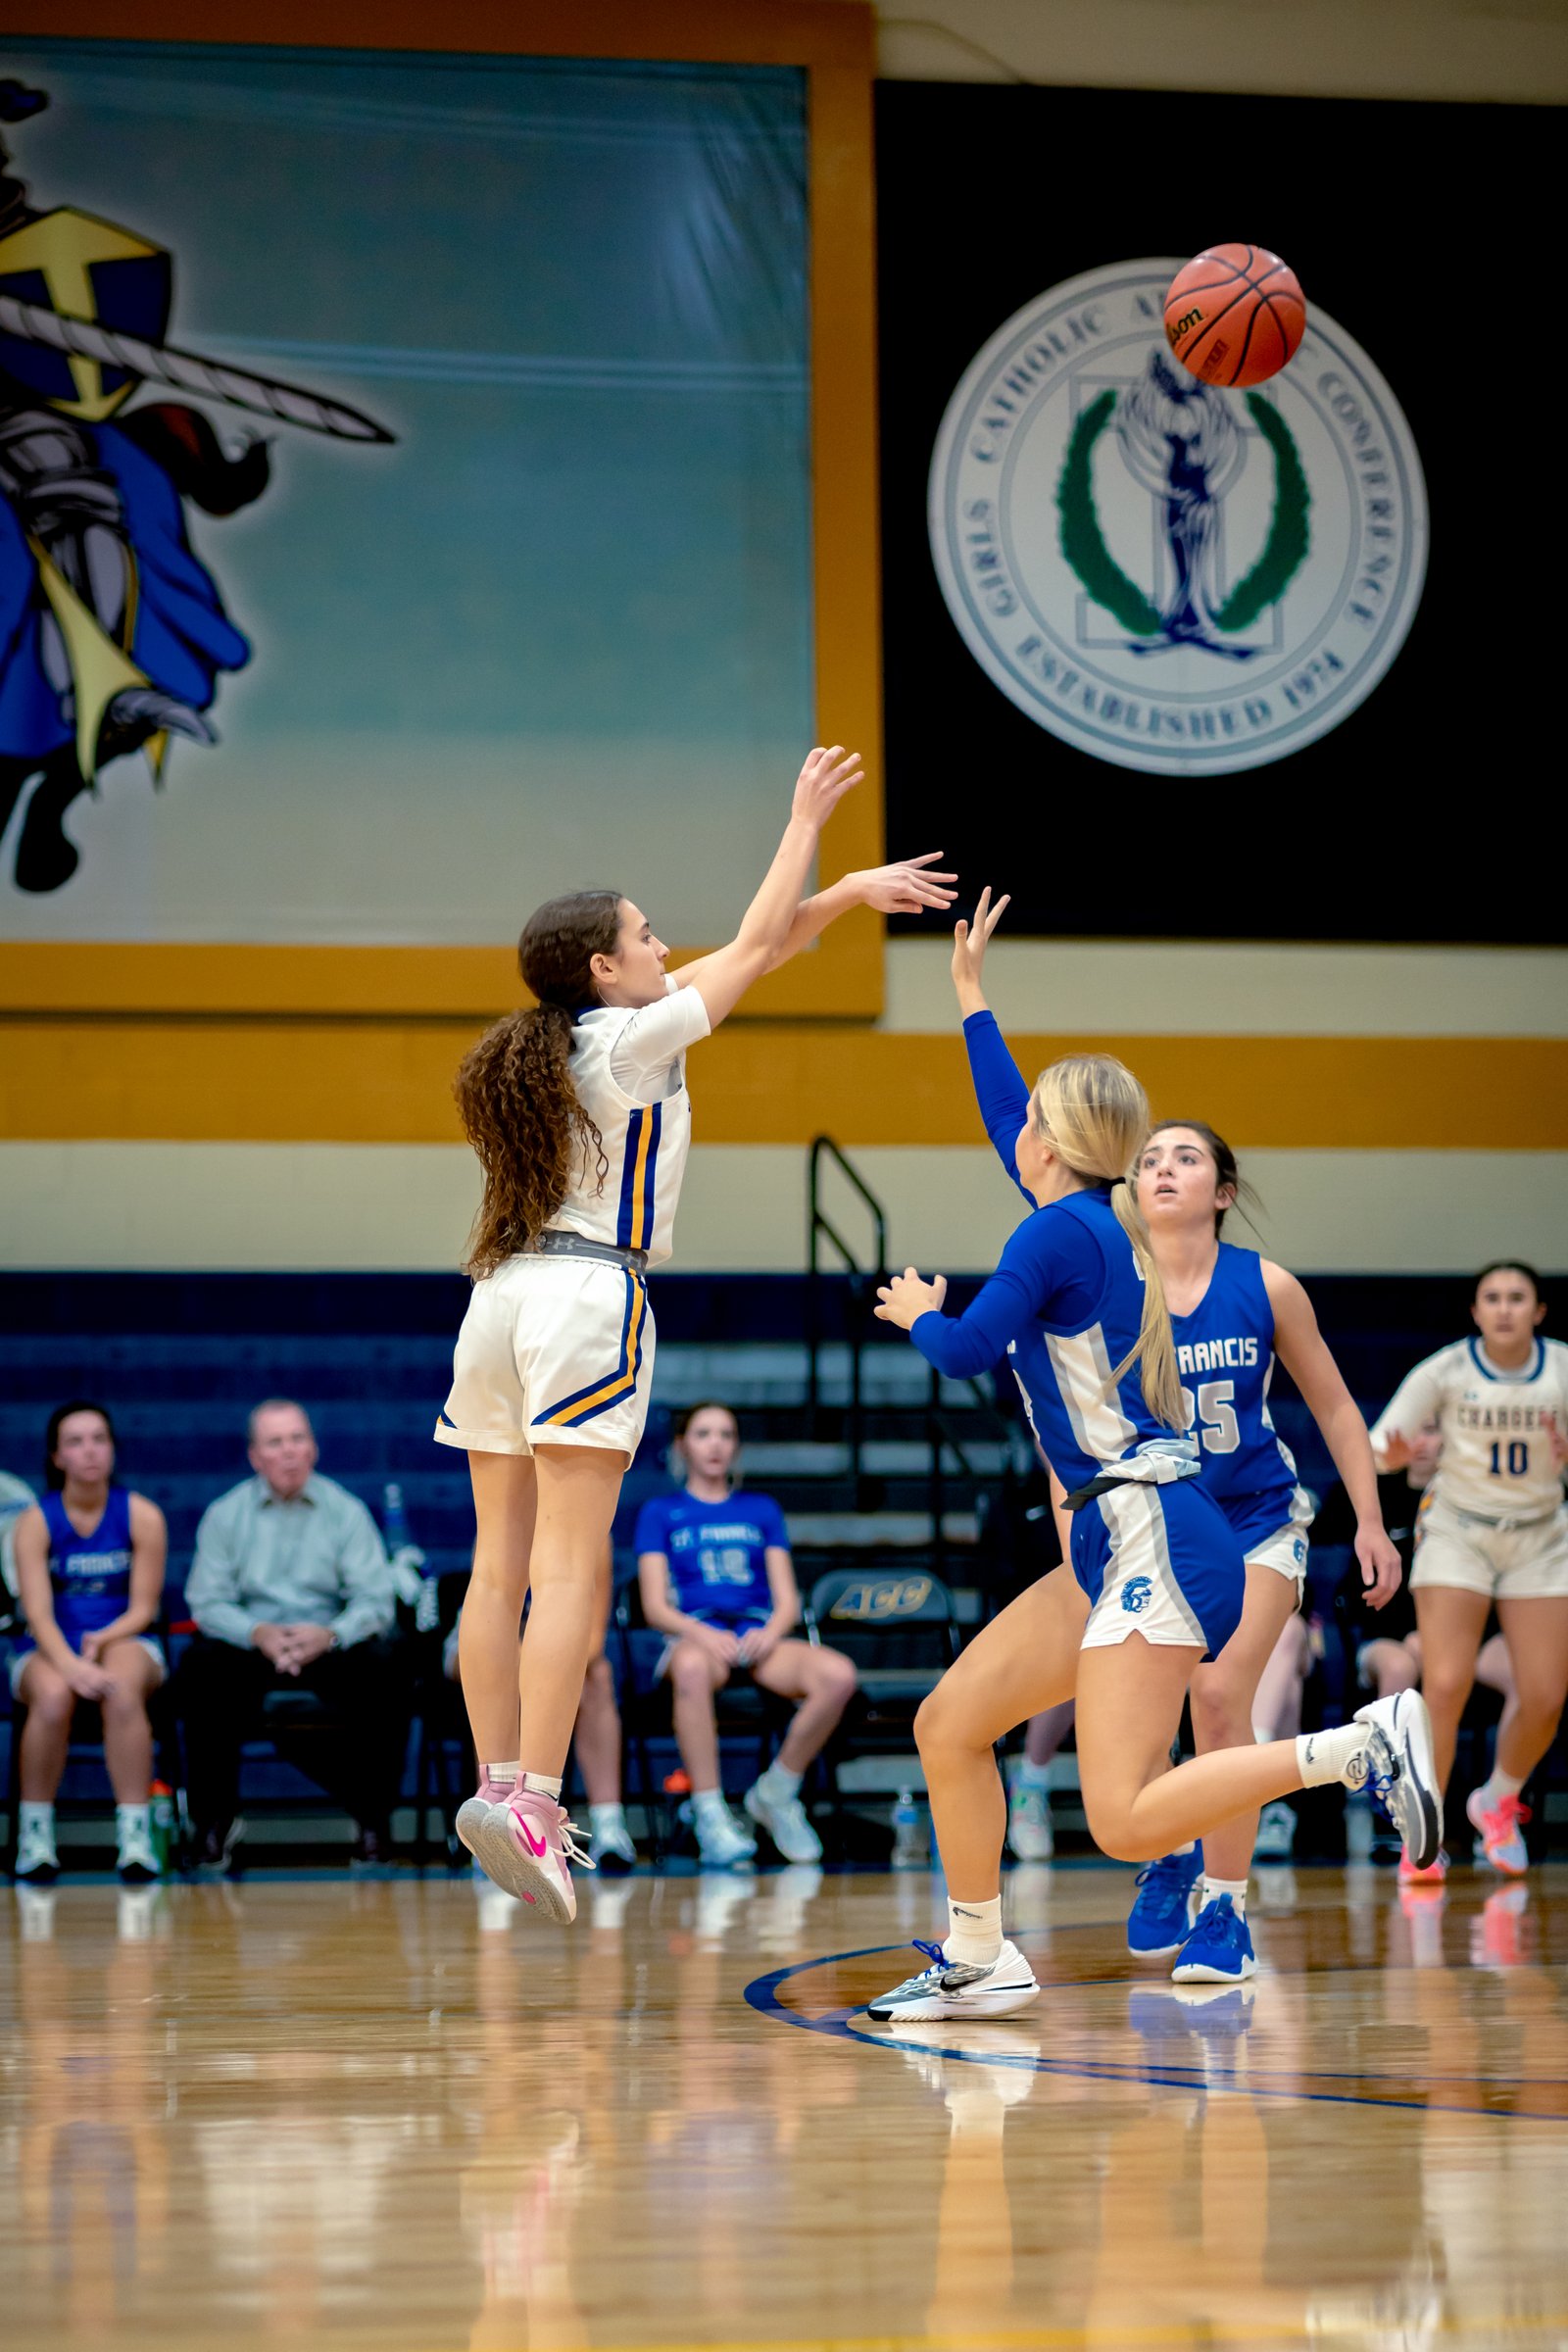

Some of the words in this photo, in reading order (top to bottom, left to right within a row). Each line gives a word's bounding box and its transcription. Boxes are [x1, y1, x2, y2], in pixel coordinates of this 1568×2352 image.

[970, 303, 1114, 465] CATHOLIC
[1015, 634, 1272, 742] ESTABLISHED
[1175, 1337, 1258, 1375] RANCIS
[1489, 1439, 1530, 1477] 10
